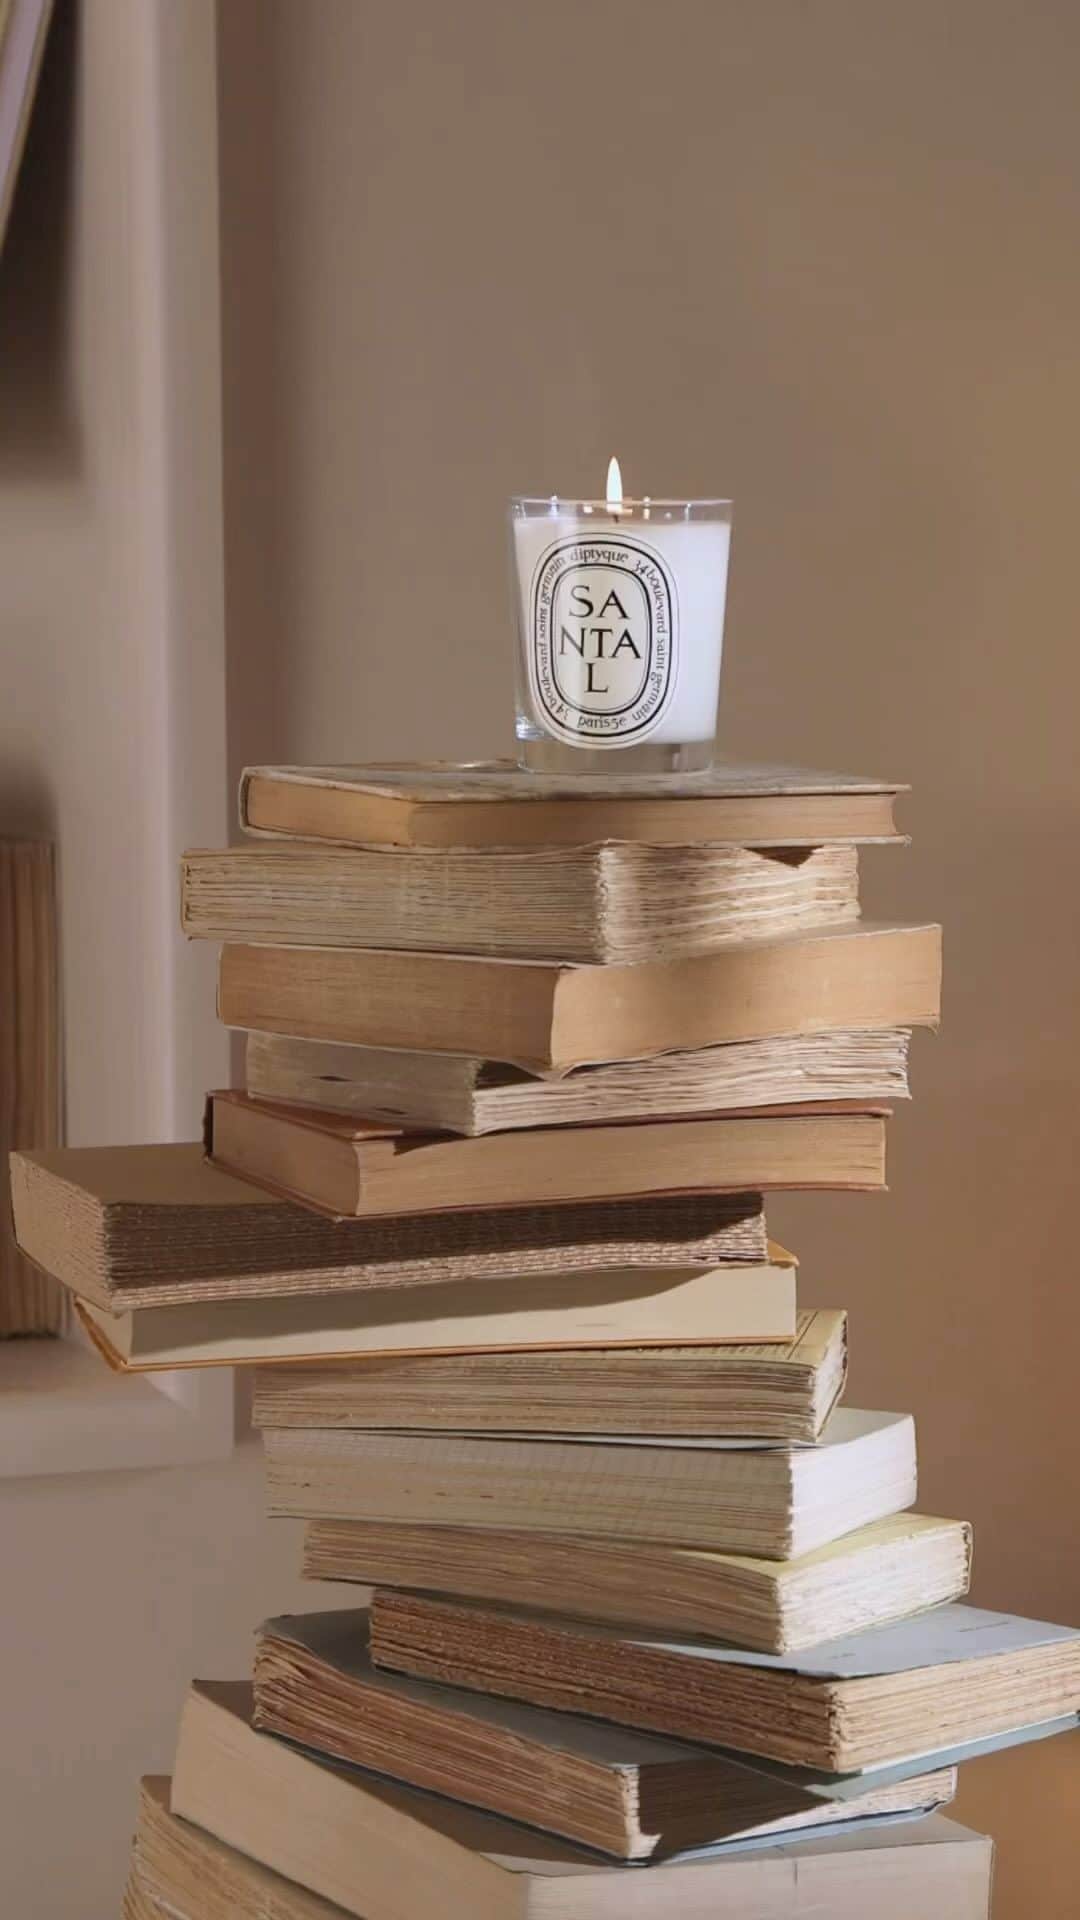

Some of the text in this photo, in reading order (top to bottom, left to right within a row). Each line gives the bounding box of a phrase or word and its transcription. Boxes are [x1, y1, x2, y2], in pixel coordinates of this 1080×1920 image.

[570, 548, 630, 563] diptyque
[569, 584, 631, 619] SA
[560, 624, 642, 660] NTA
[631, 559, 668, 722] 34 boulevard saint germain
[584, 662, 609, 693] L
[555, 704, 571, 721] 34
